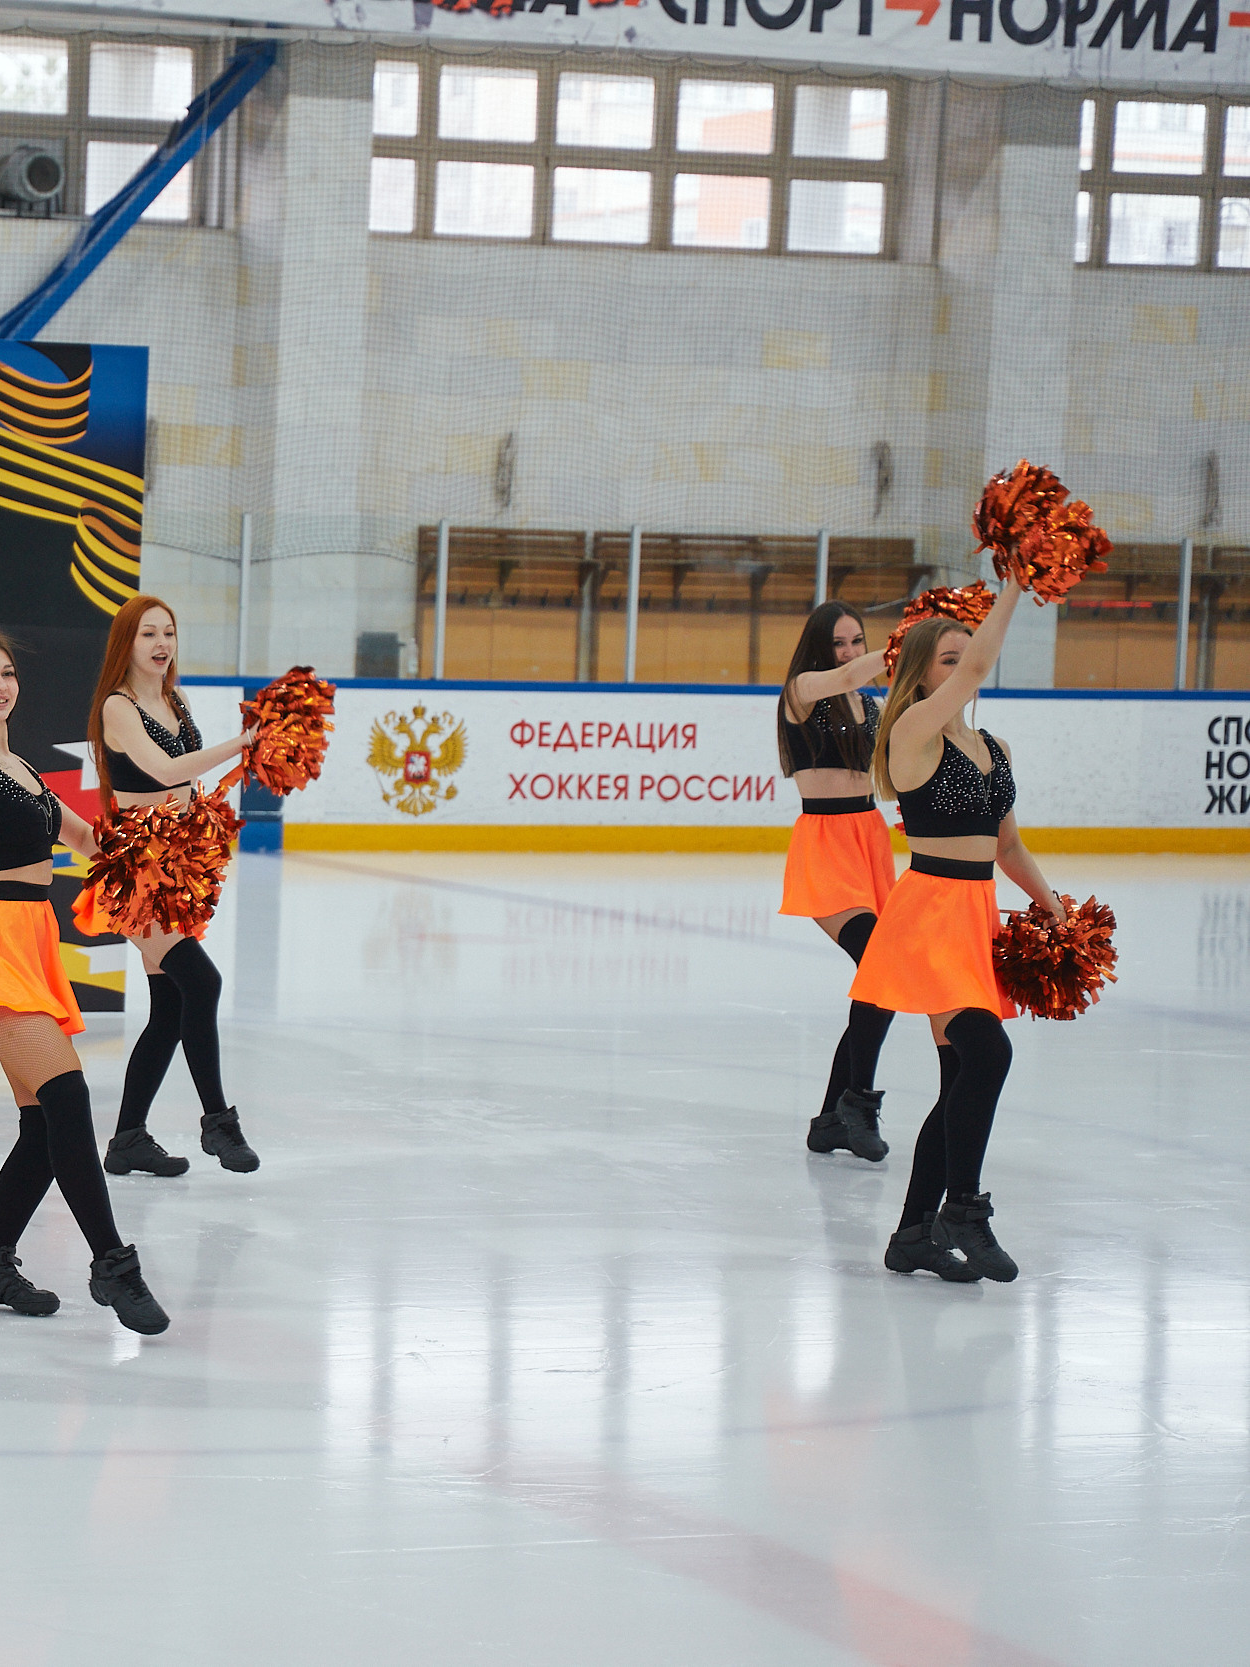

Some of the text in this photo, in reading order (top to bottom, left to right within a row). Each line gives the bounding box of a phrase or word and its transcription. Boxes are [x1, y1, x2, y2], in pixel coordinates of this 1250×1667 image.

[949, 0, 1220, 53] НОРМА
[510, 719, 697, 752] ФЕДЕРАЦИЯ
[1208, 716, 1250, 745] СП
[508, 773, 776, 801] ХОККЕЯ РОССИИ
